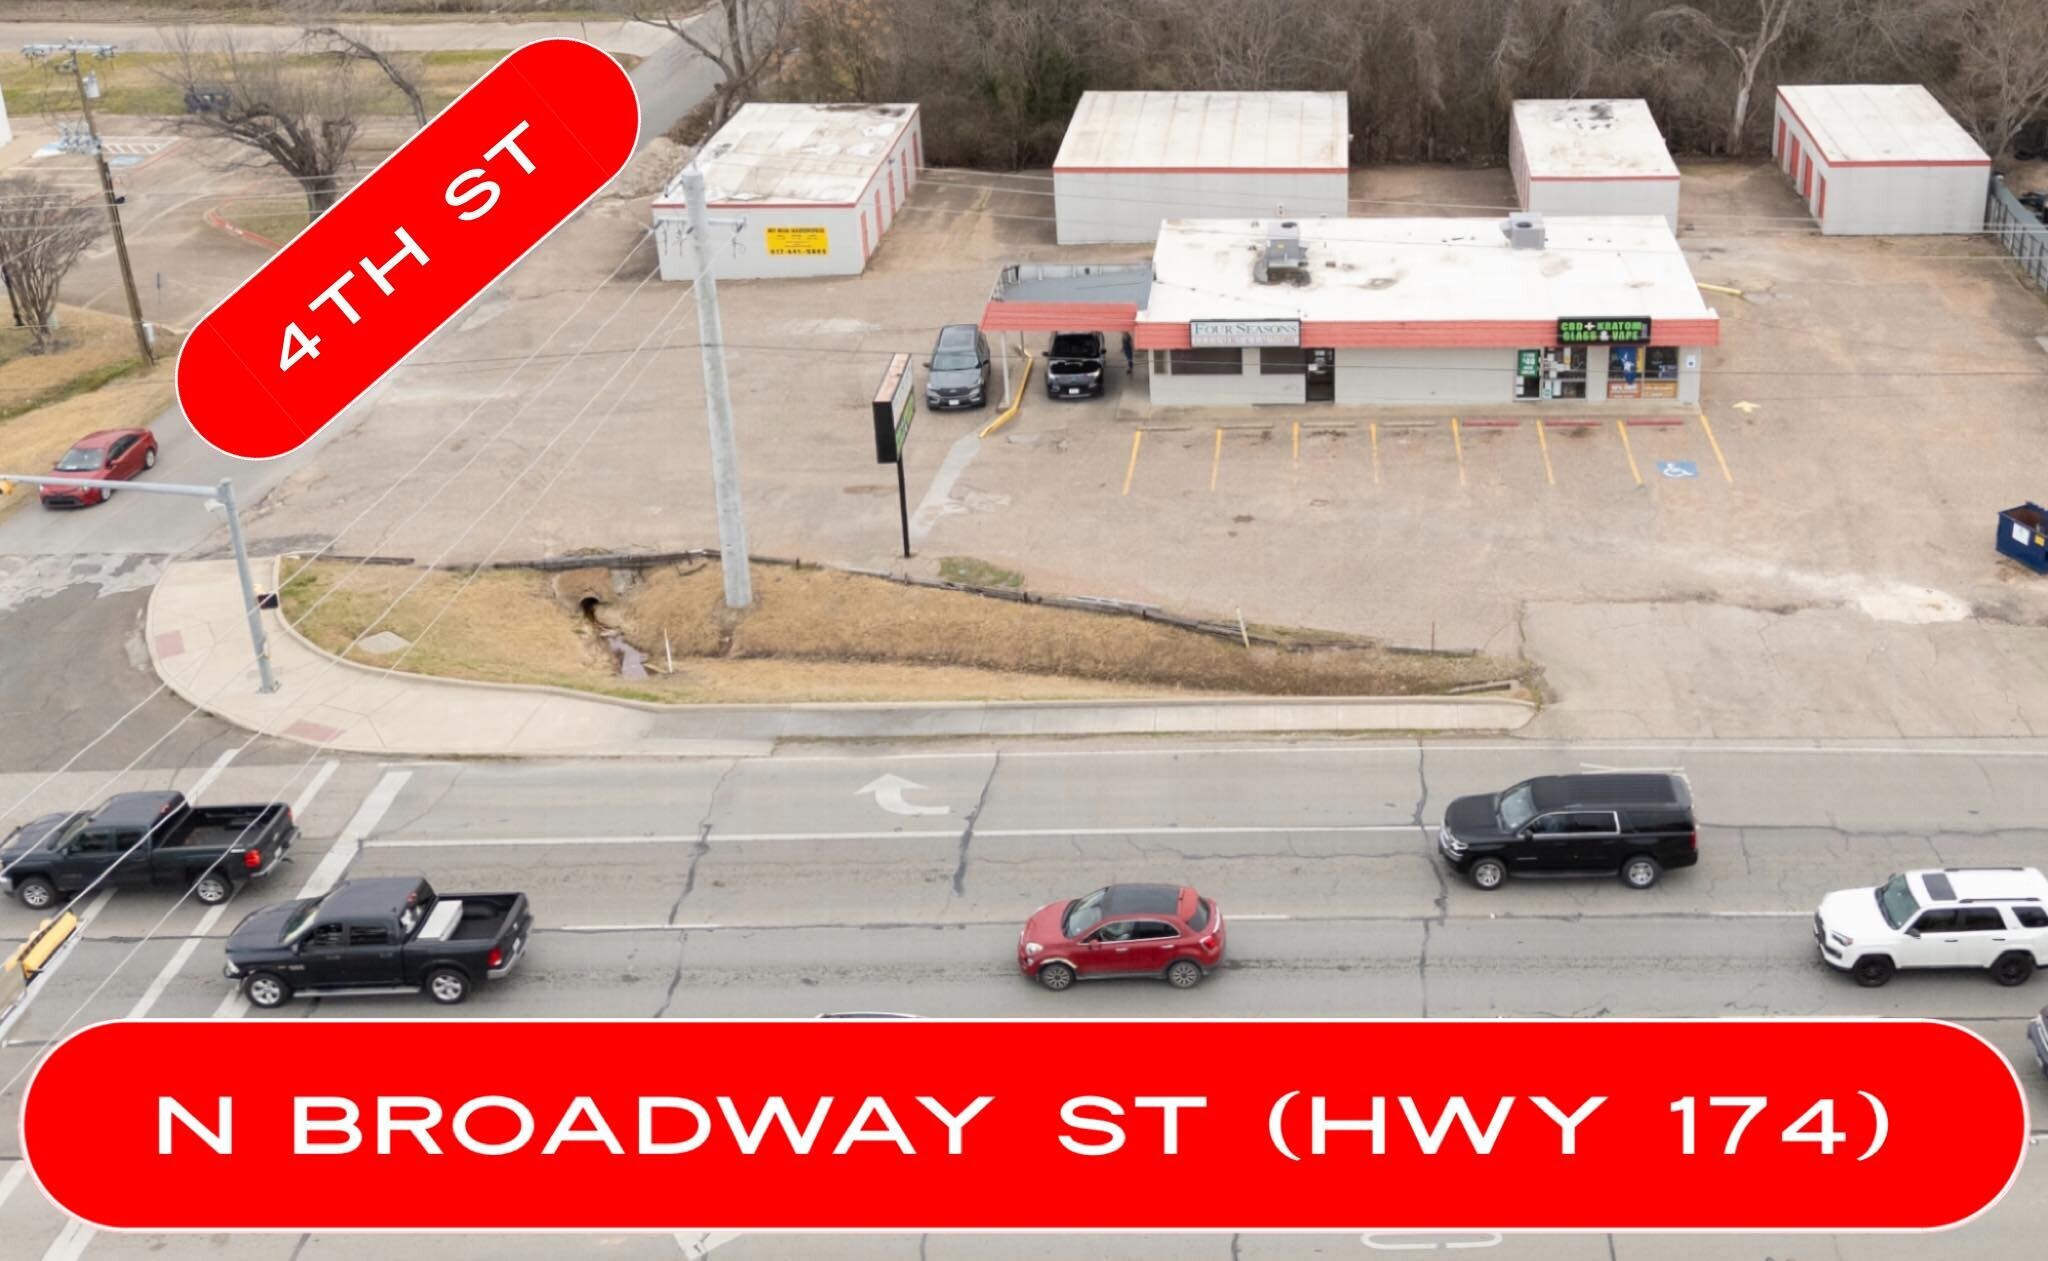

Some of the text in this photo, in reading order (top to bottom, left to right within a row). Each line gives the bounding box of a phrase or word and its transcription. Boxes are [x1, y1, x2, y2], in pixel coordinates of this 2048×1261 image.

[1195, 323, 1297, 335] FOUR SEASONS
[1612, 331, 1639, 341] VAPE
